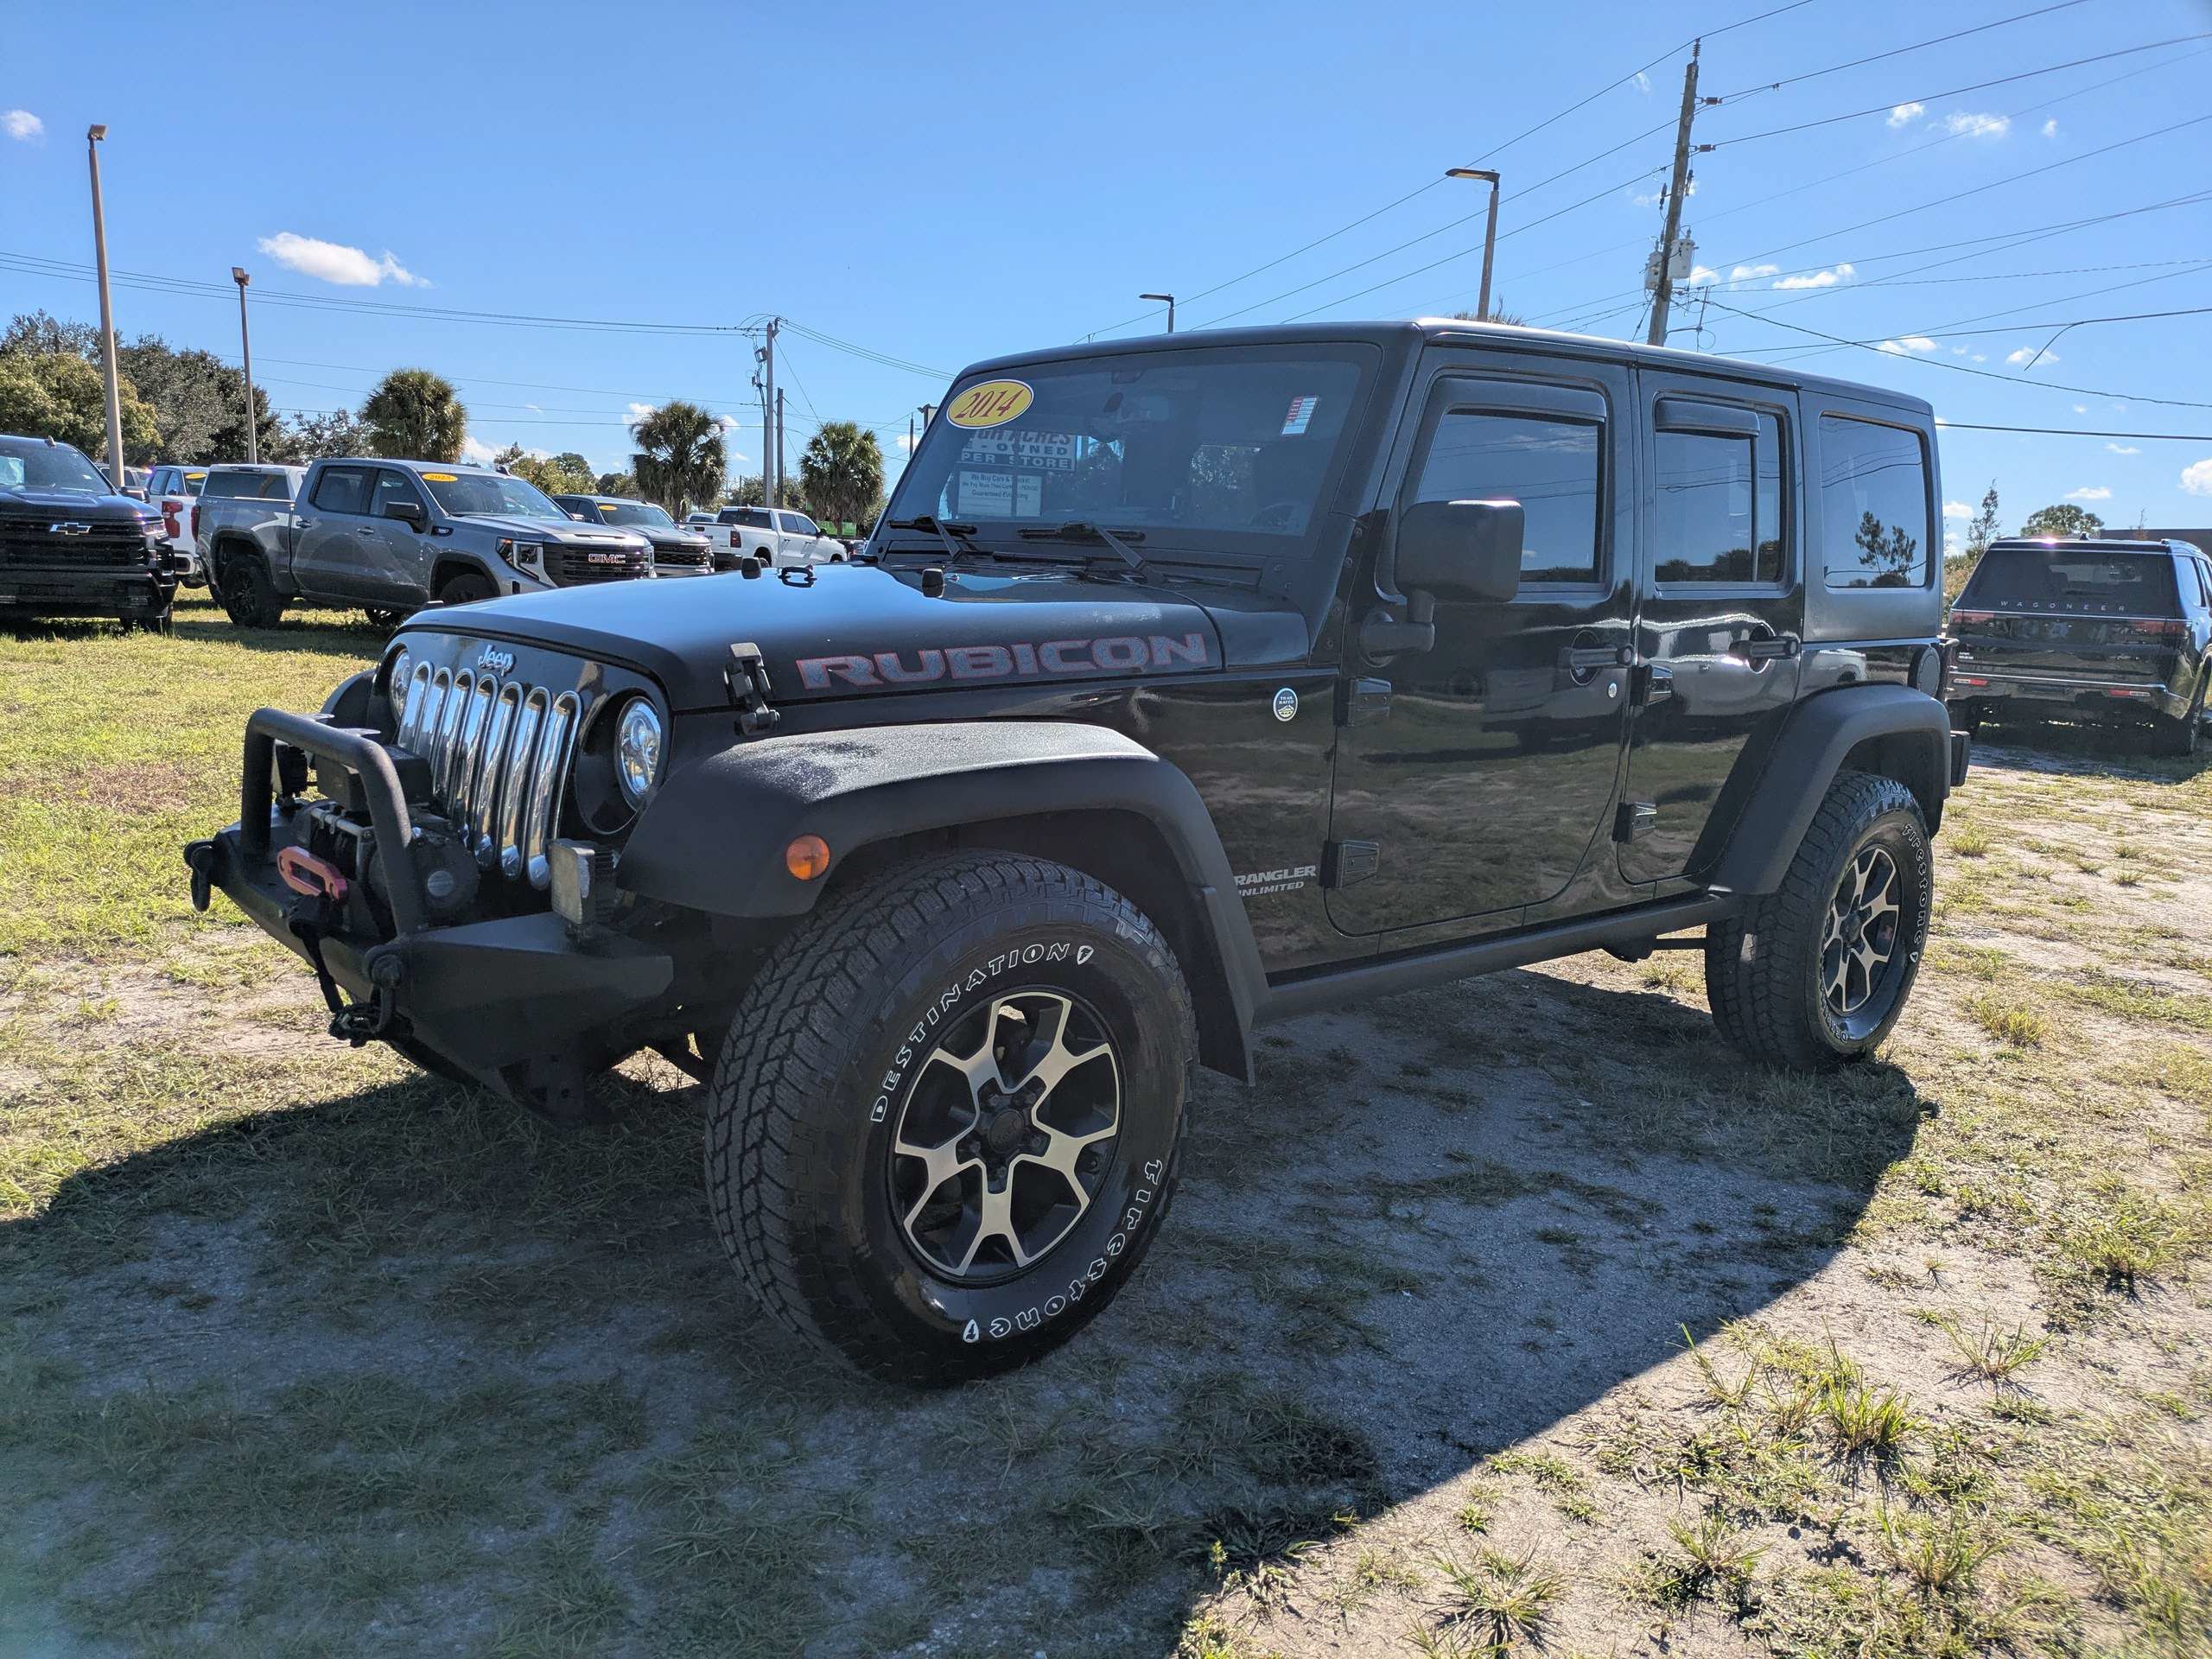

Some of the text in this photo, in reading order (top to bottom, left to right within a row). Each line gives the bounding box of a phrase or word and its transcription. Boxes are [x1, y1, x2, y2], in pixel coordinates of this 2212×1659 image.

[954, 389, 1023, 419] 2014
[1008, 456, 1069, 468] STORE
[588, 554, 626, 563] GMC
[2000, 601, 2125, 612] WAGONEER
[477, 644, 514, 677] Jeep
[795, 632, 1207, 690] RUBICON
[1233, 865, 1317, 886] RANGLER
[1902, 823, 1929, 945] Firestone
[870, 942, 1071, 1122] DESTINATION
[989, 1160, 1163, 1338] Firestone
